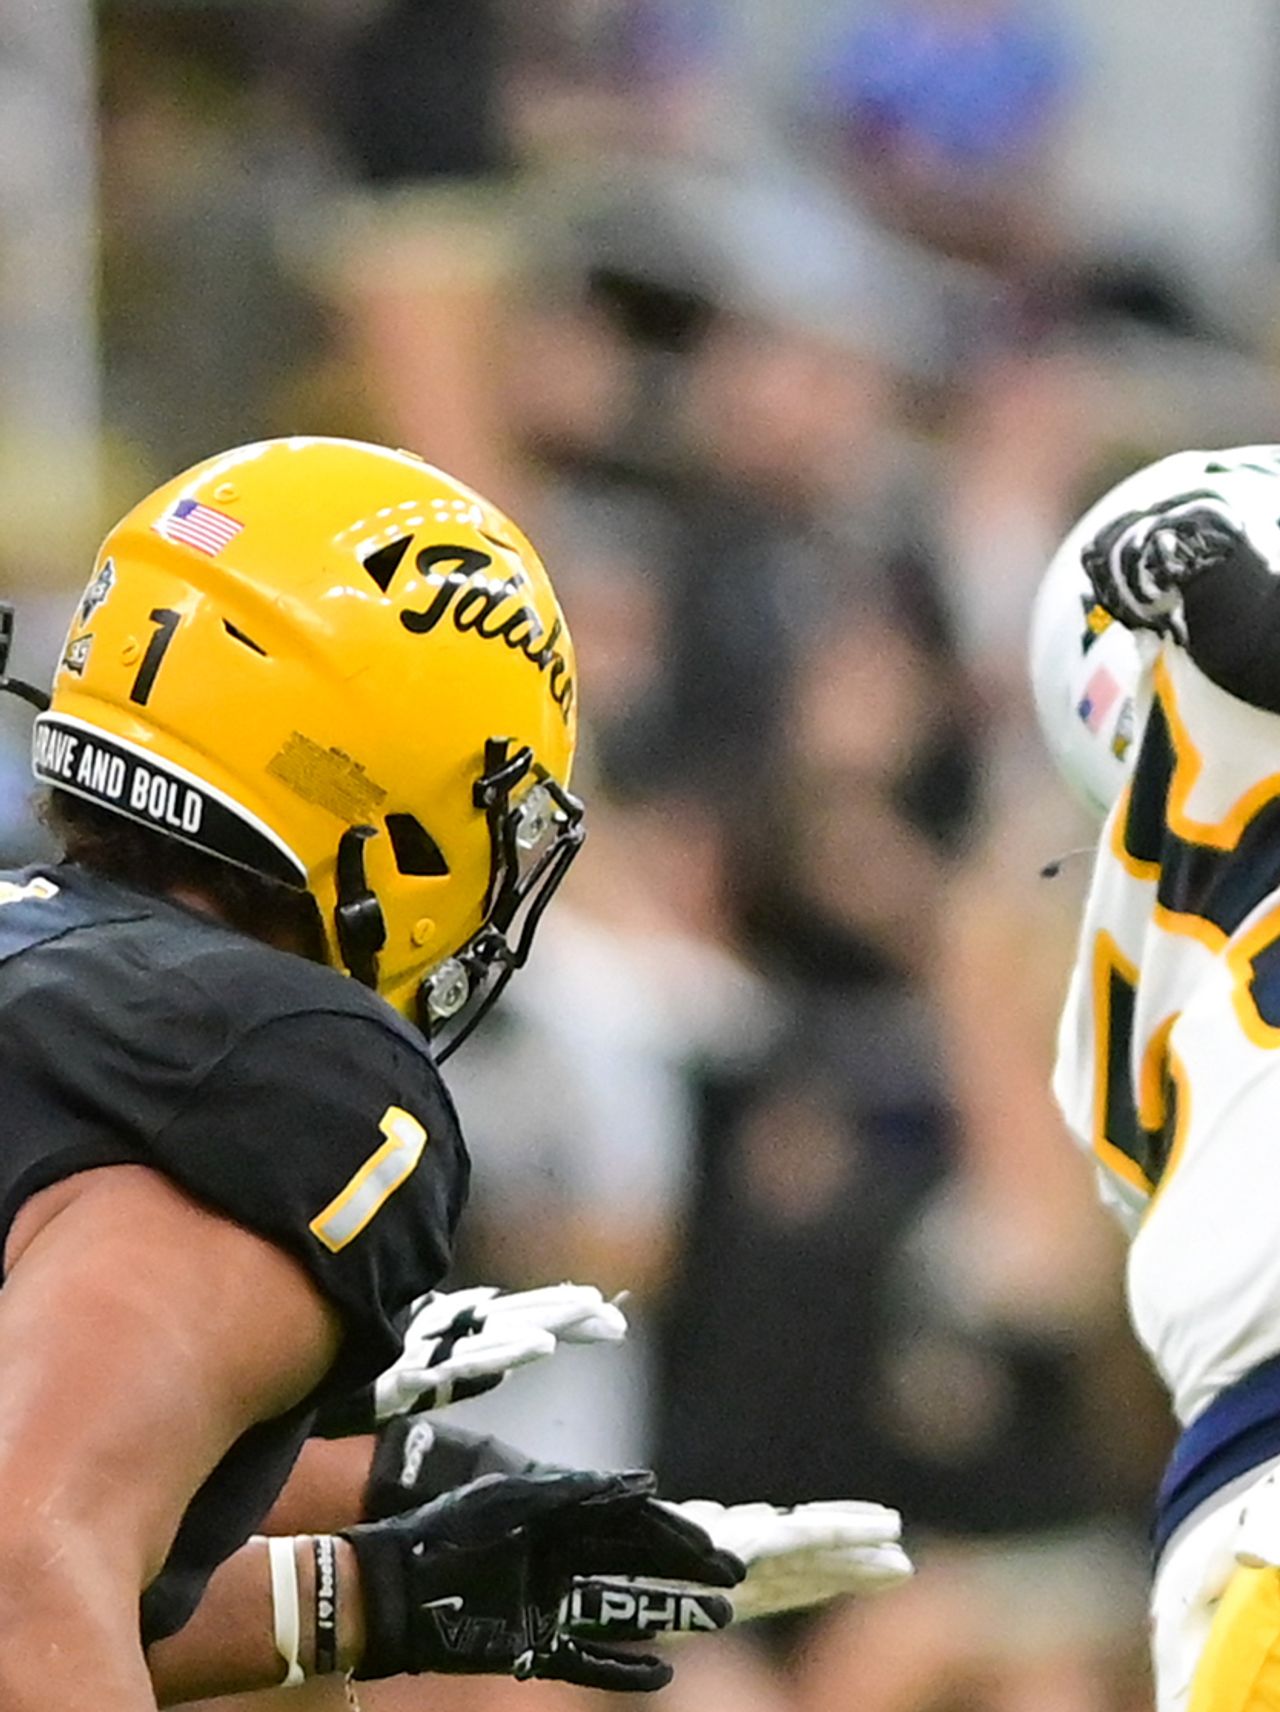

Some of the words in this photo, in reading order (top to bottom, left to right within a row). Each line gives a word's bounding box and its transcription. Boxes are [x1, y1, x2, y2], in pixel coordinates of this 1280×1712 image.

[129, 607, 182, 707] 1
[76, 743, 126, 799] AND
[130, 766, 203, 834] BOLD
[309, 1105, 428, 1254] 1
